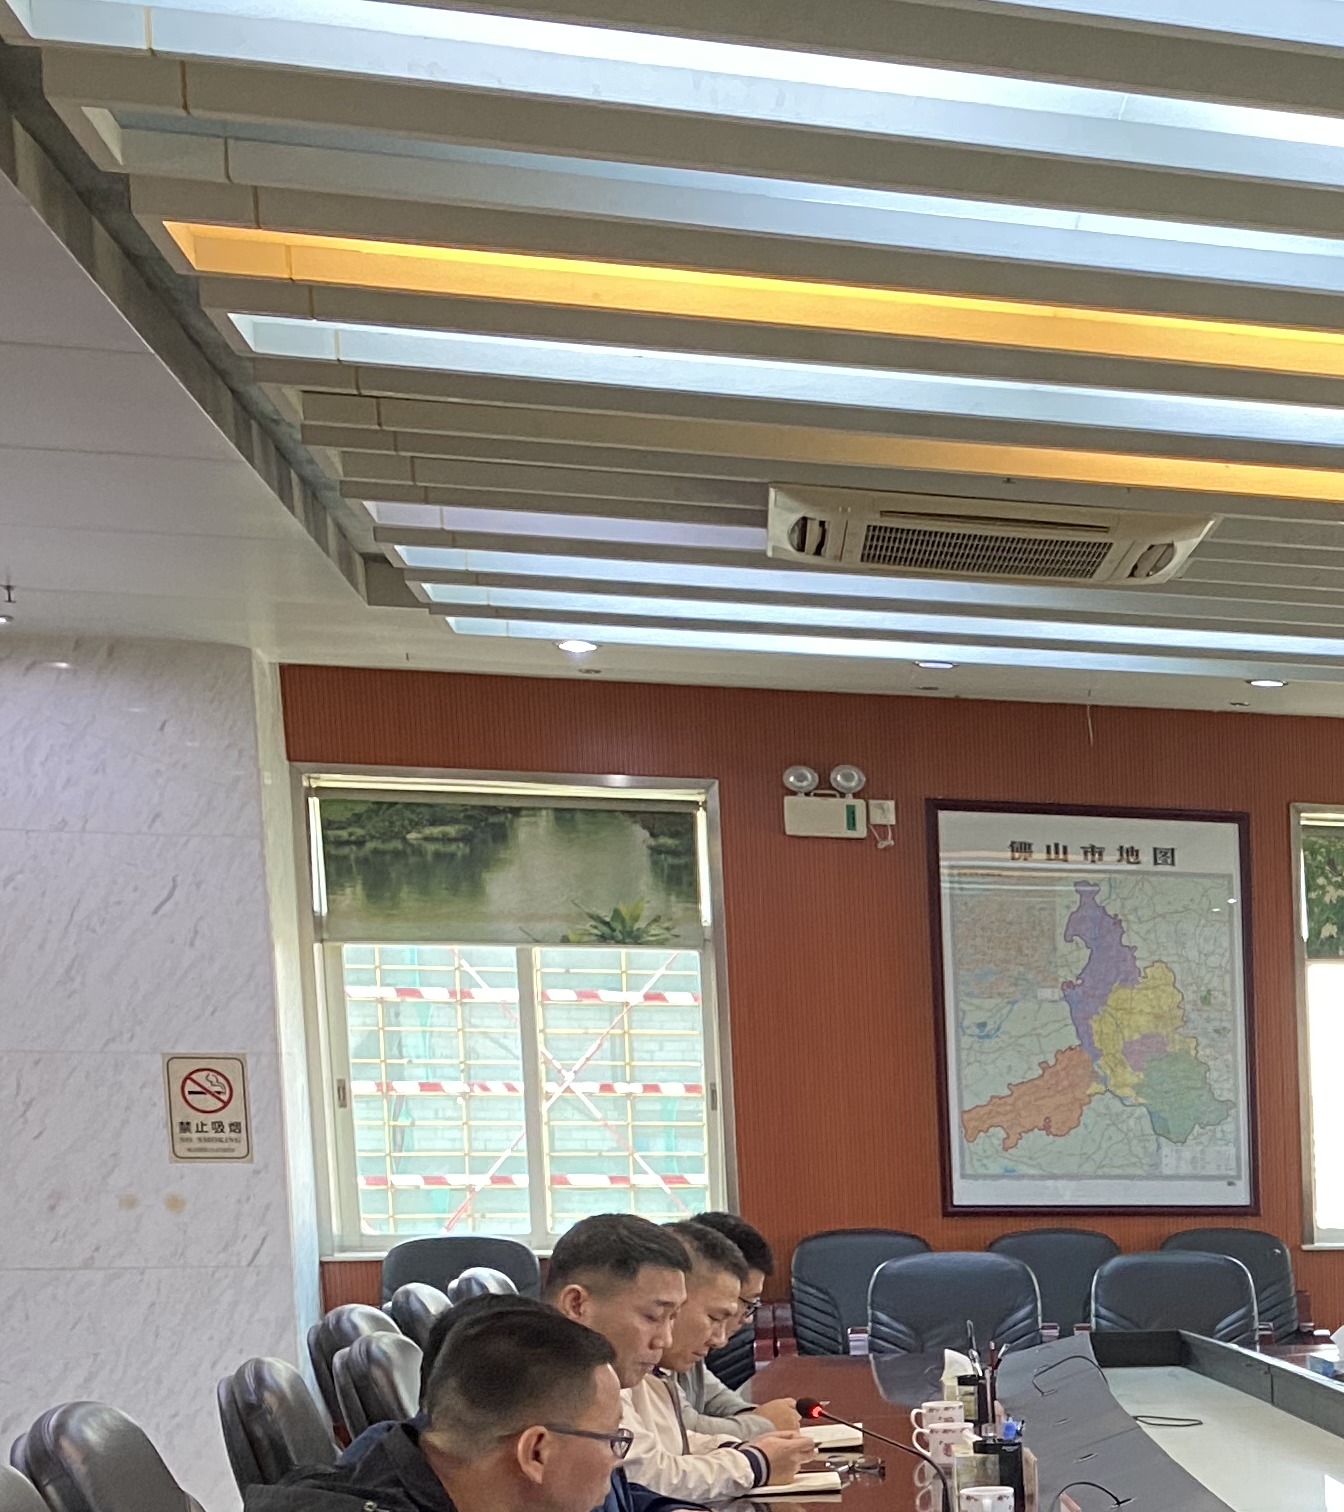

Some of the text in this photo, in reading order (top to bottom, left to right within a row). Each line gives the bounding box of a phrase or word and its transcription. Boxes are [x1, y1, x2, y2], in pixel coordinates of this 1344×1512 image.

[1008, 840, 1176, 866] 佛山市地图
[178, 1121, 242, 1134] 禁止吸烟
